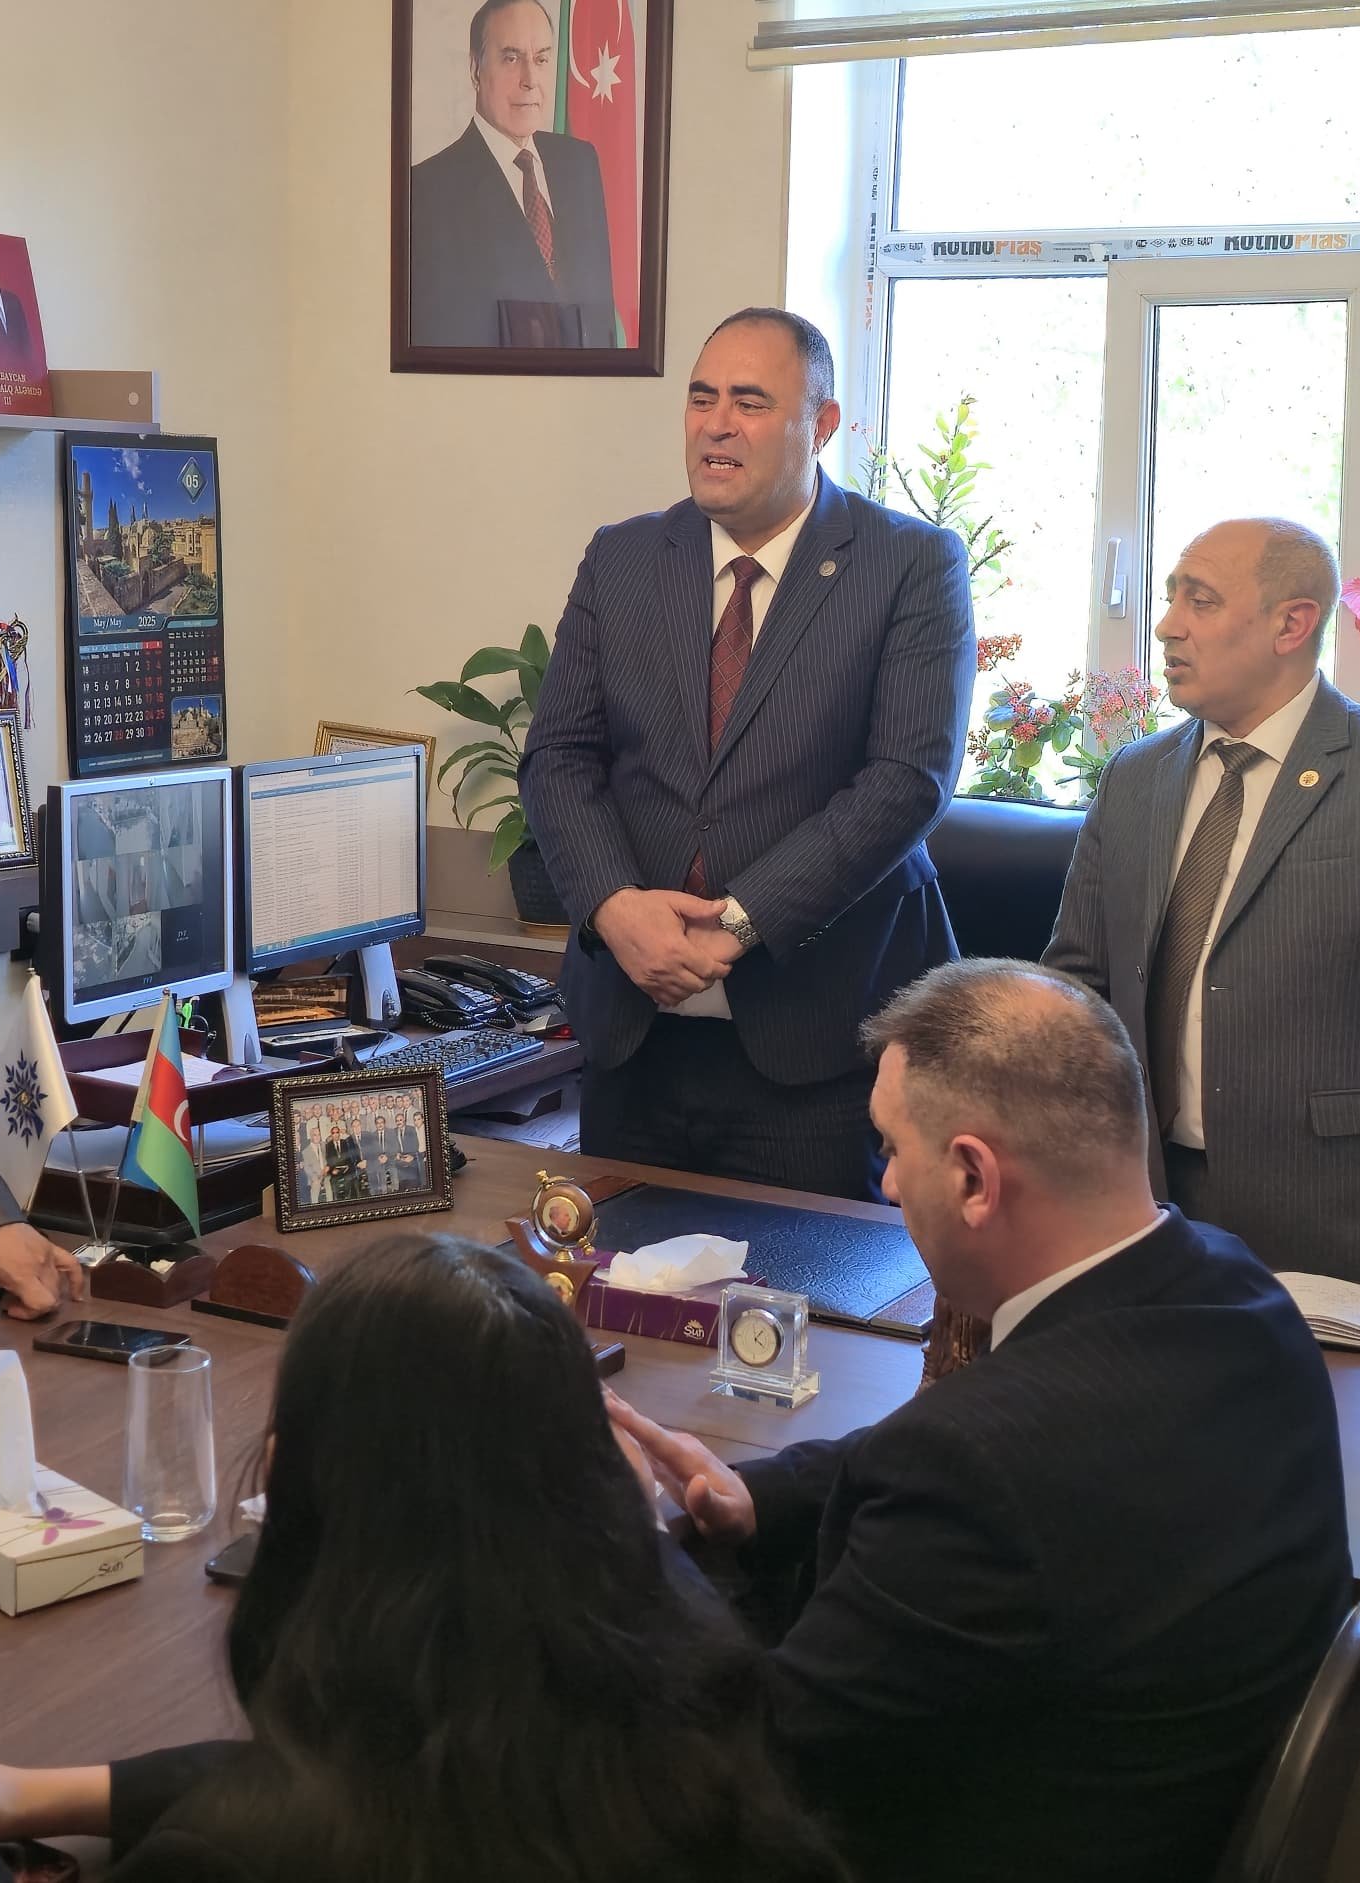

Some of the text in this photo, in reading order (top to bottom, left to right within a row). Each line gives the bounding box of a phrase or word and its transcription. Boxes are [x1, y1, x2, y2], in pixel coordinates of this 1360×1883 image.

[185, 474, 199, 488] 05
[138, 616, 156, 627] 2025
[125, 661, 129, 672] 1
[135, 661, 140, 672] 2
[83, 683, 90, 692] 19
[94, 681, 99, 692] 5
[104, 680, 109, 691] 6
[114, 679, 120, 690] 7
[125, 678, 130, 689] 8
[83, 700, 91, 709] 20
[93, 698, 101, 709] 12
[103, 697, 111, 709] 13
[114, 696, 122, 707] 14
[124, 695, 132, 706] 15
[135, 694, 143, 705] 16
[94, 715, 101, 726] 19
[103, 714, 113, 725] 20
[115, 713, 122, 724] 21
[124, 711, 133, 723] 22
[135, 710, 144, 722] 23
[94, 732, 103, 743] 26
[104, 731, 113, 742] 27
[125, 728, 134, 740] 29
[135, 727, 145, 738] 30
[683, 1325, 705, 1339] Sun
